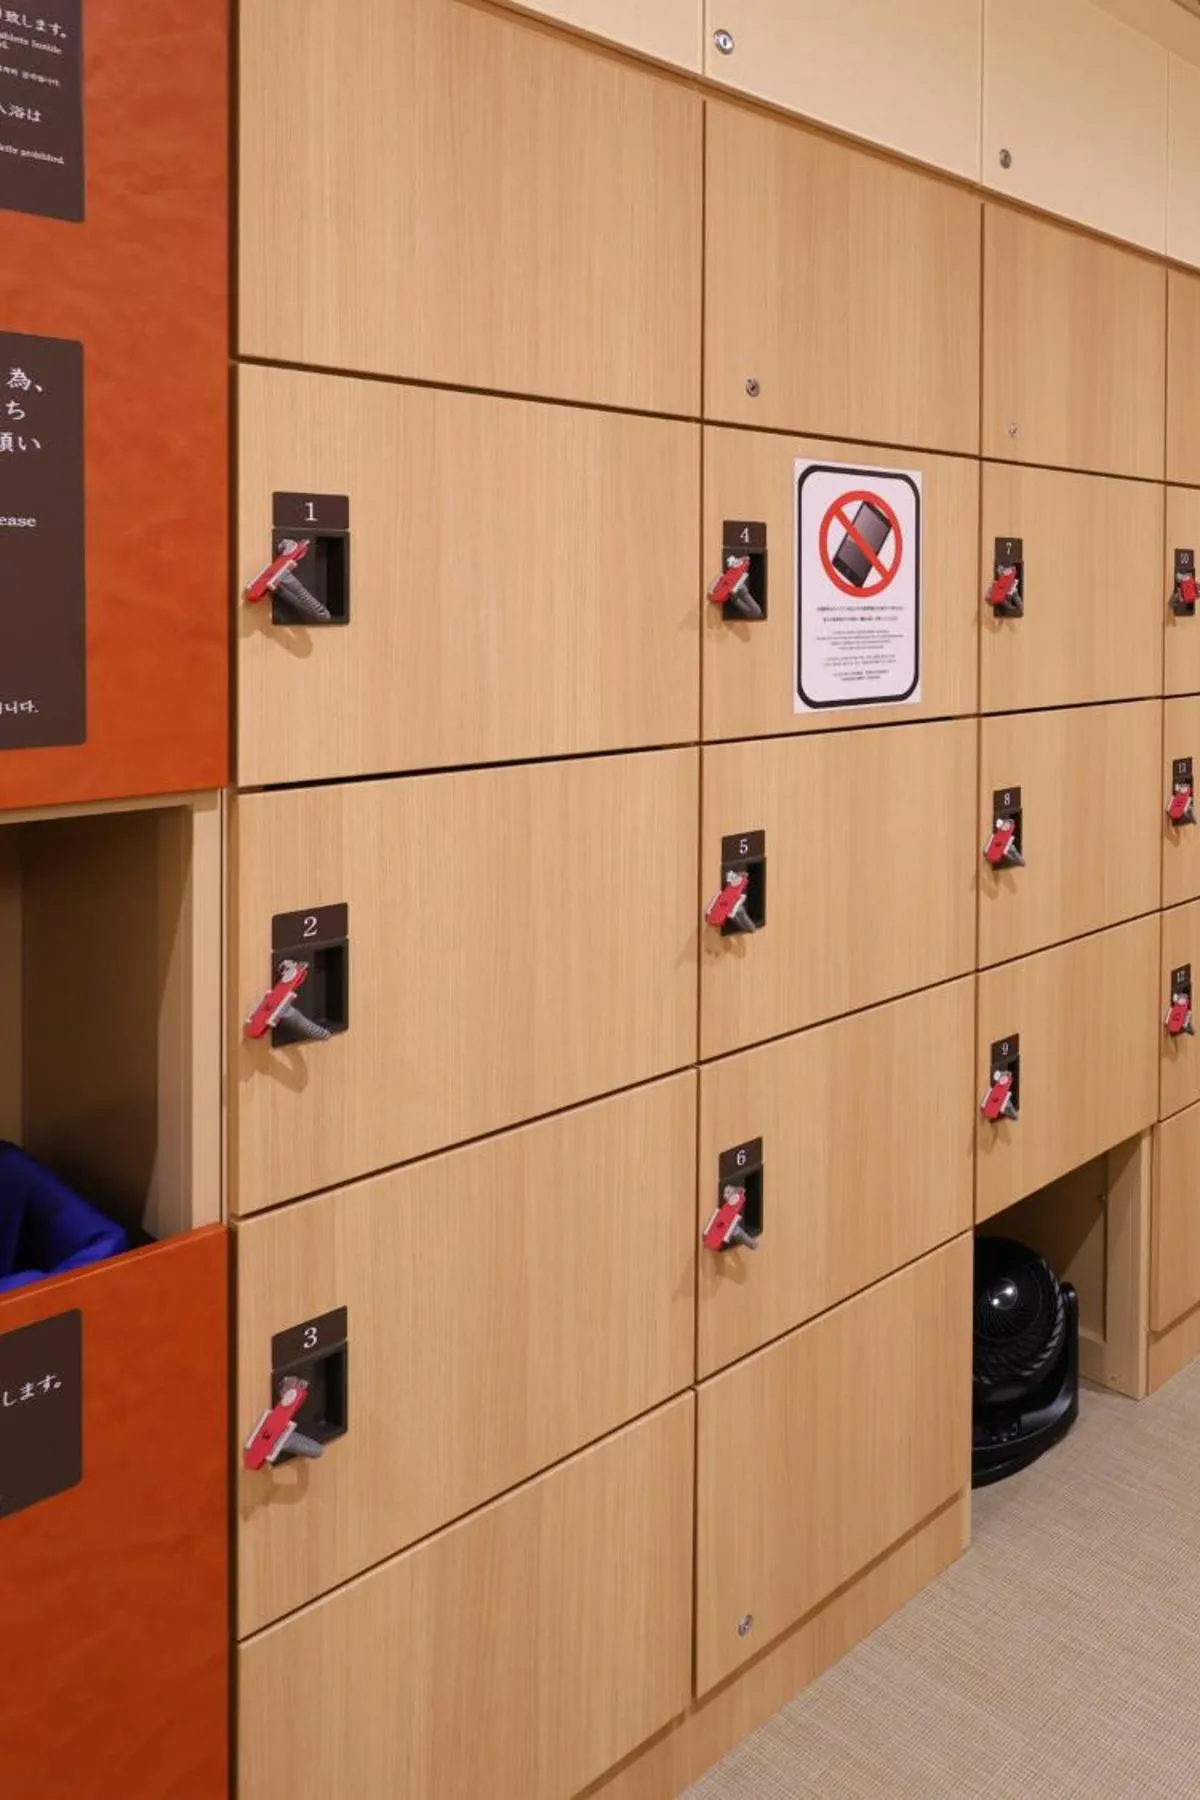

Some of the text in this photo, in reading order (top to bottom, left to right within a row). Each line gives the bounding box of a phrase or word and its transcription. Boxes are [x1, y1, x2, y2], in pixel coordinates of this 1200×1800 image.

[0, 8, 67, 39] 致します。
[5, 400, 26, 420] ち
[304, 502, 318, 522] 1
[740, 527, 750, 543] 4
[1005, 542, 1012, 556] 7
[0, 700, 39, 714] 니다.
[1003, 792, 1011, 806] 8
[739, 838, 749, 855] 5
[303, 916, 318, 937] 2
[736, 1149, 747, 1166] 6
[303, 1327, 318, 1349] 3
[3, 1374, 61, 1407] します。
